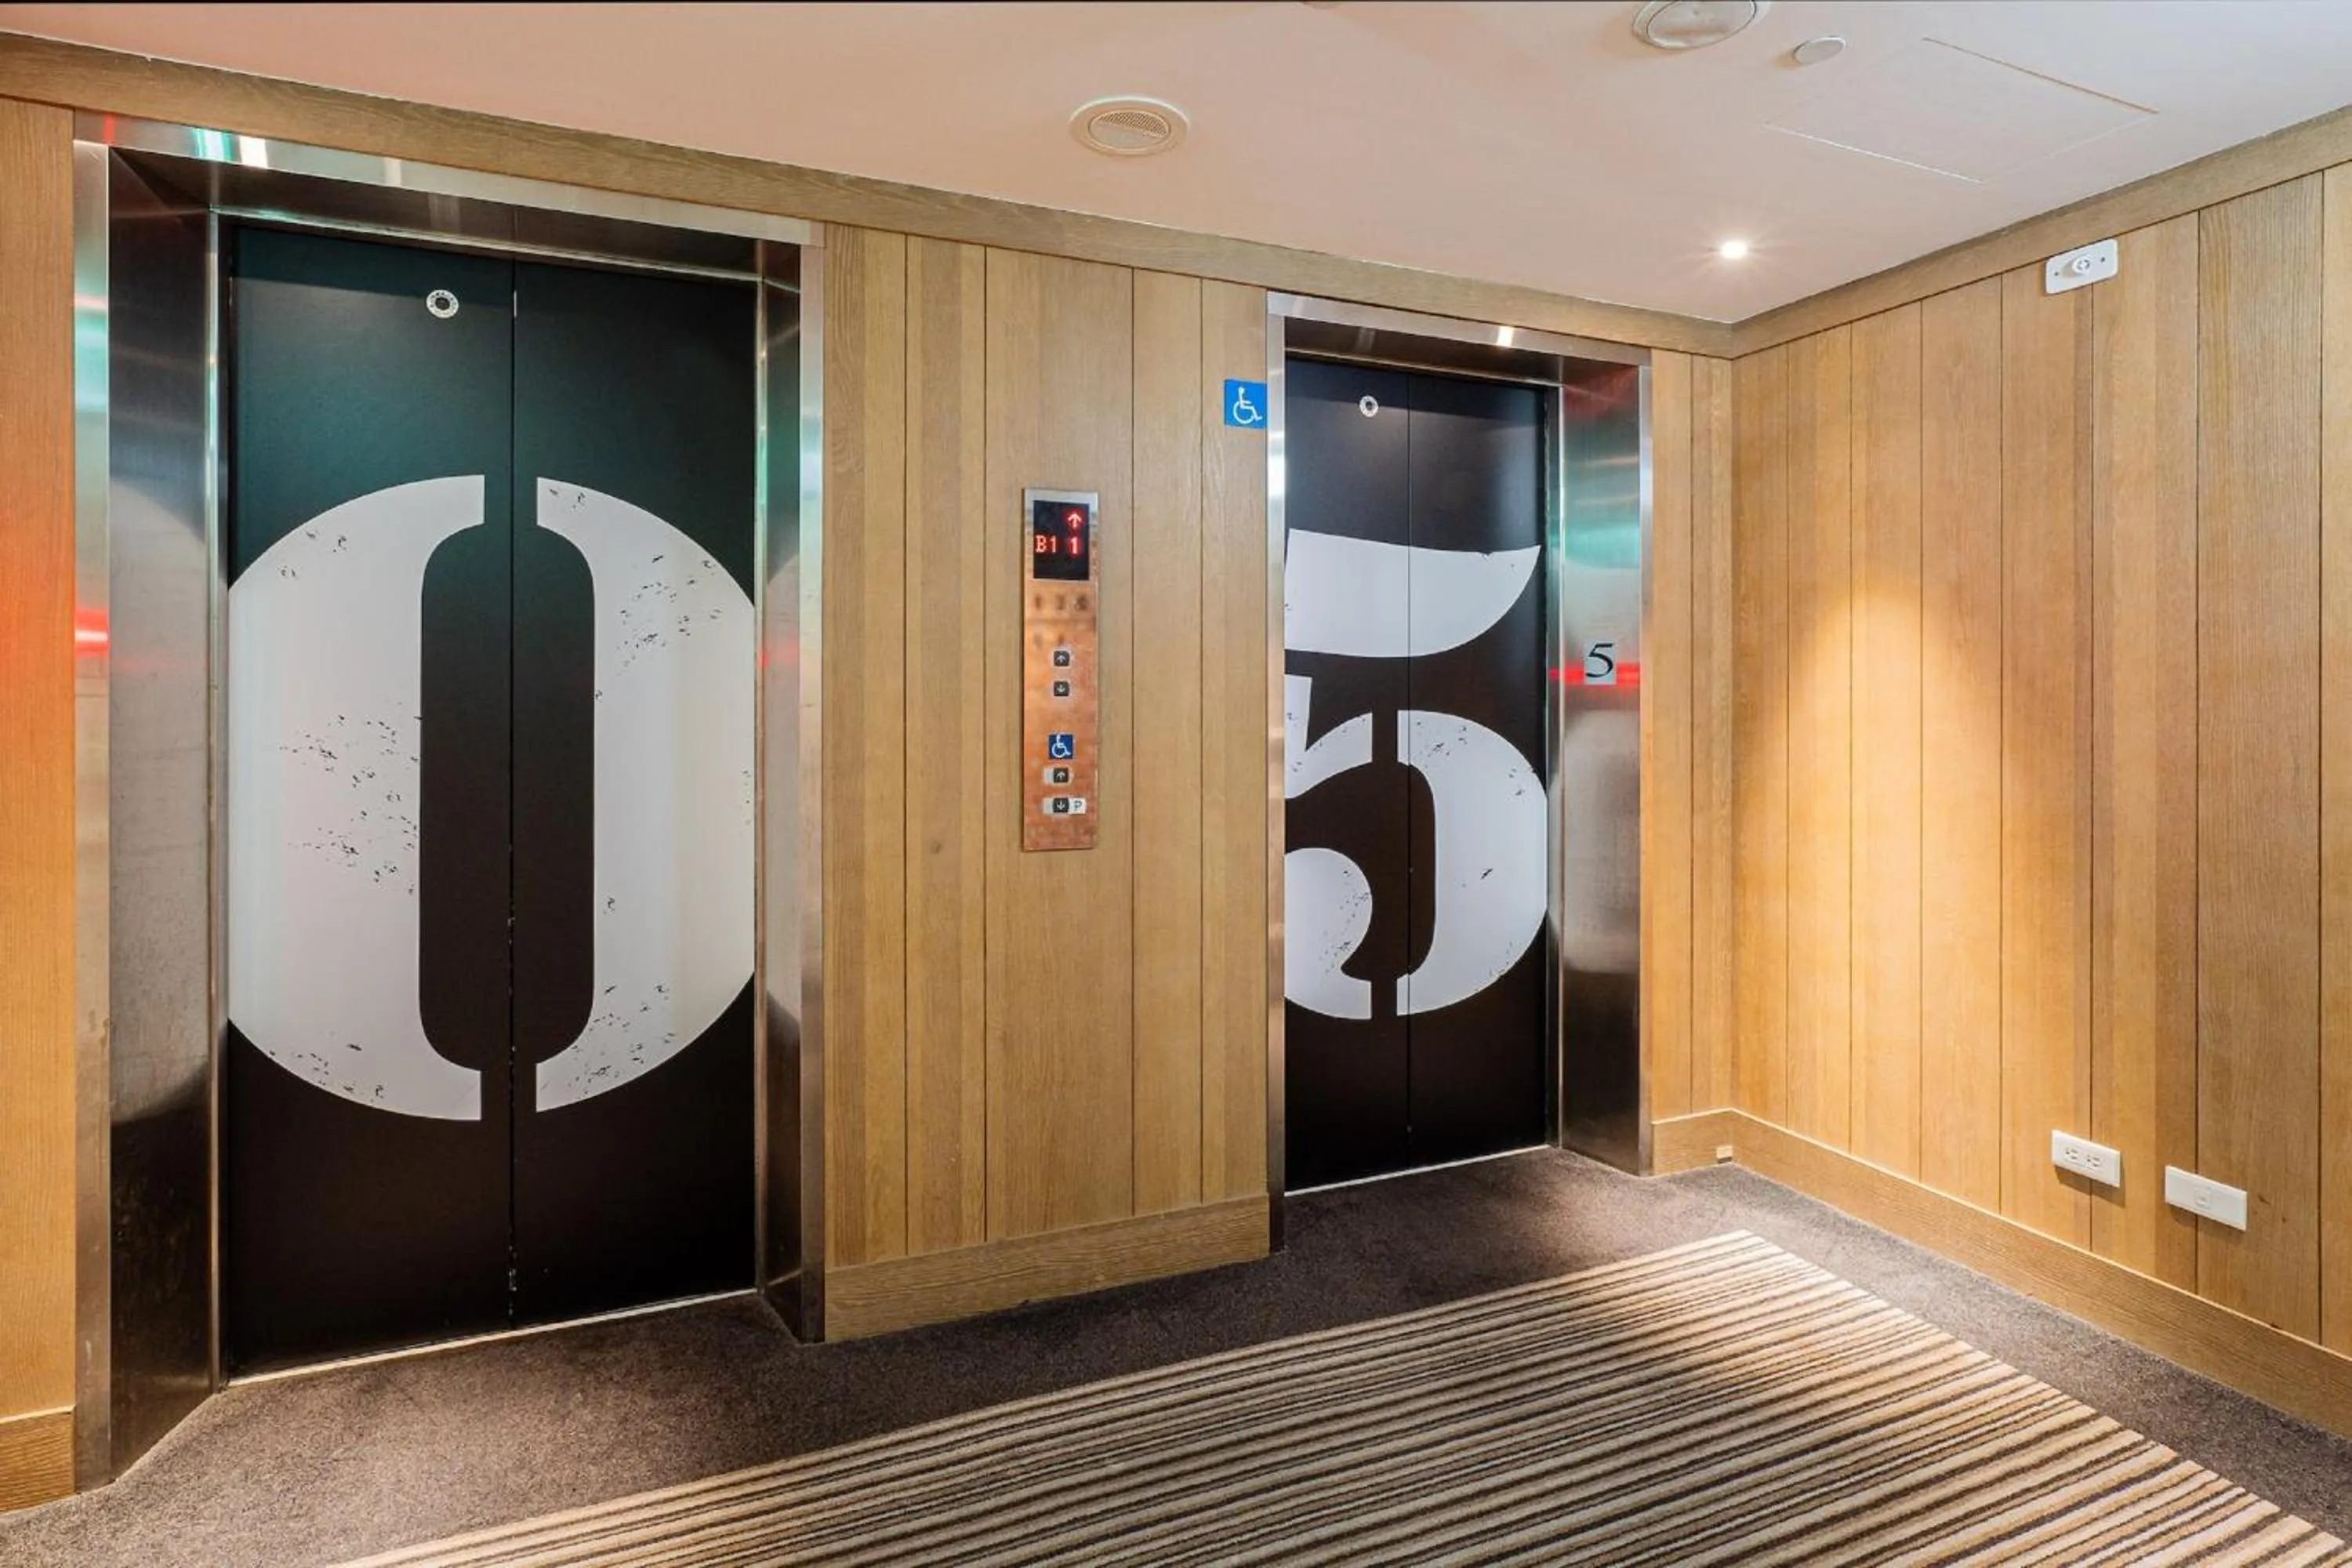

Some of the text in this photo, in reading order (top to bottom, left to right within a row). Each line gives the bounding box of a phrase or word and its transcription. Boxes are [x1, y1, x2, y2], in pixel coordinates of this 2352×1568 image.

[1035, 535, 1078, 554] B1 1
[1585, 643, 1613, 678] 5
[228, 474, 1547, 1121] 0 5
[1074, 800, 1083, 811] P
